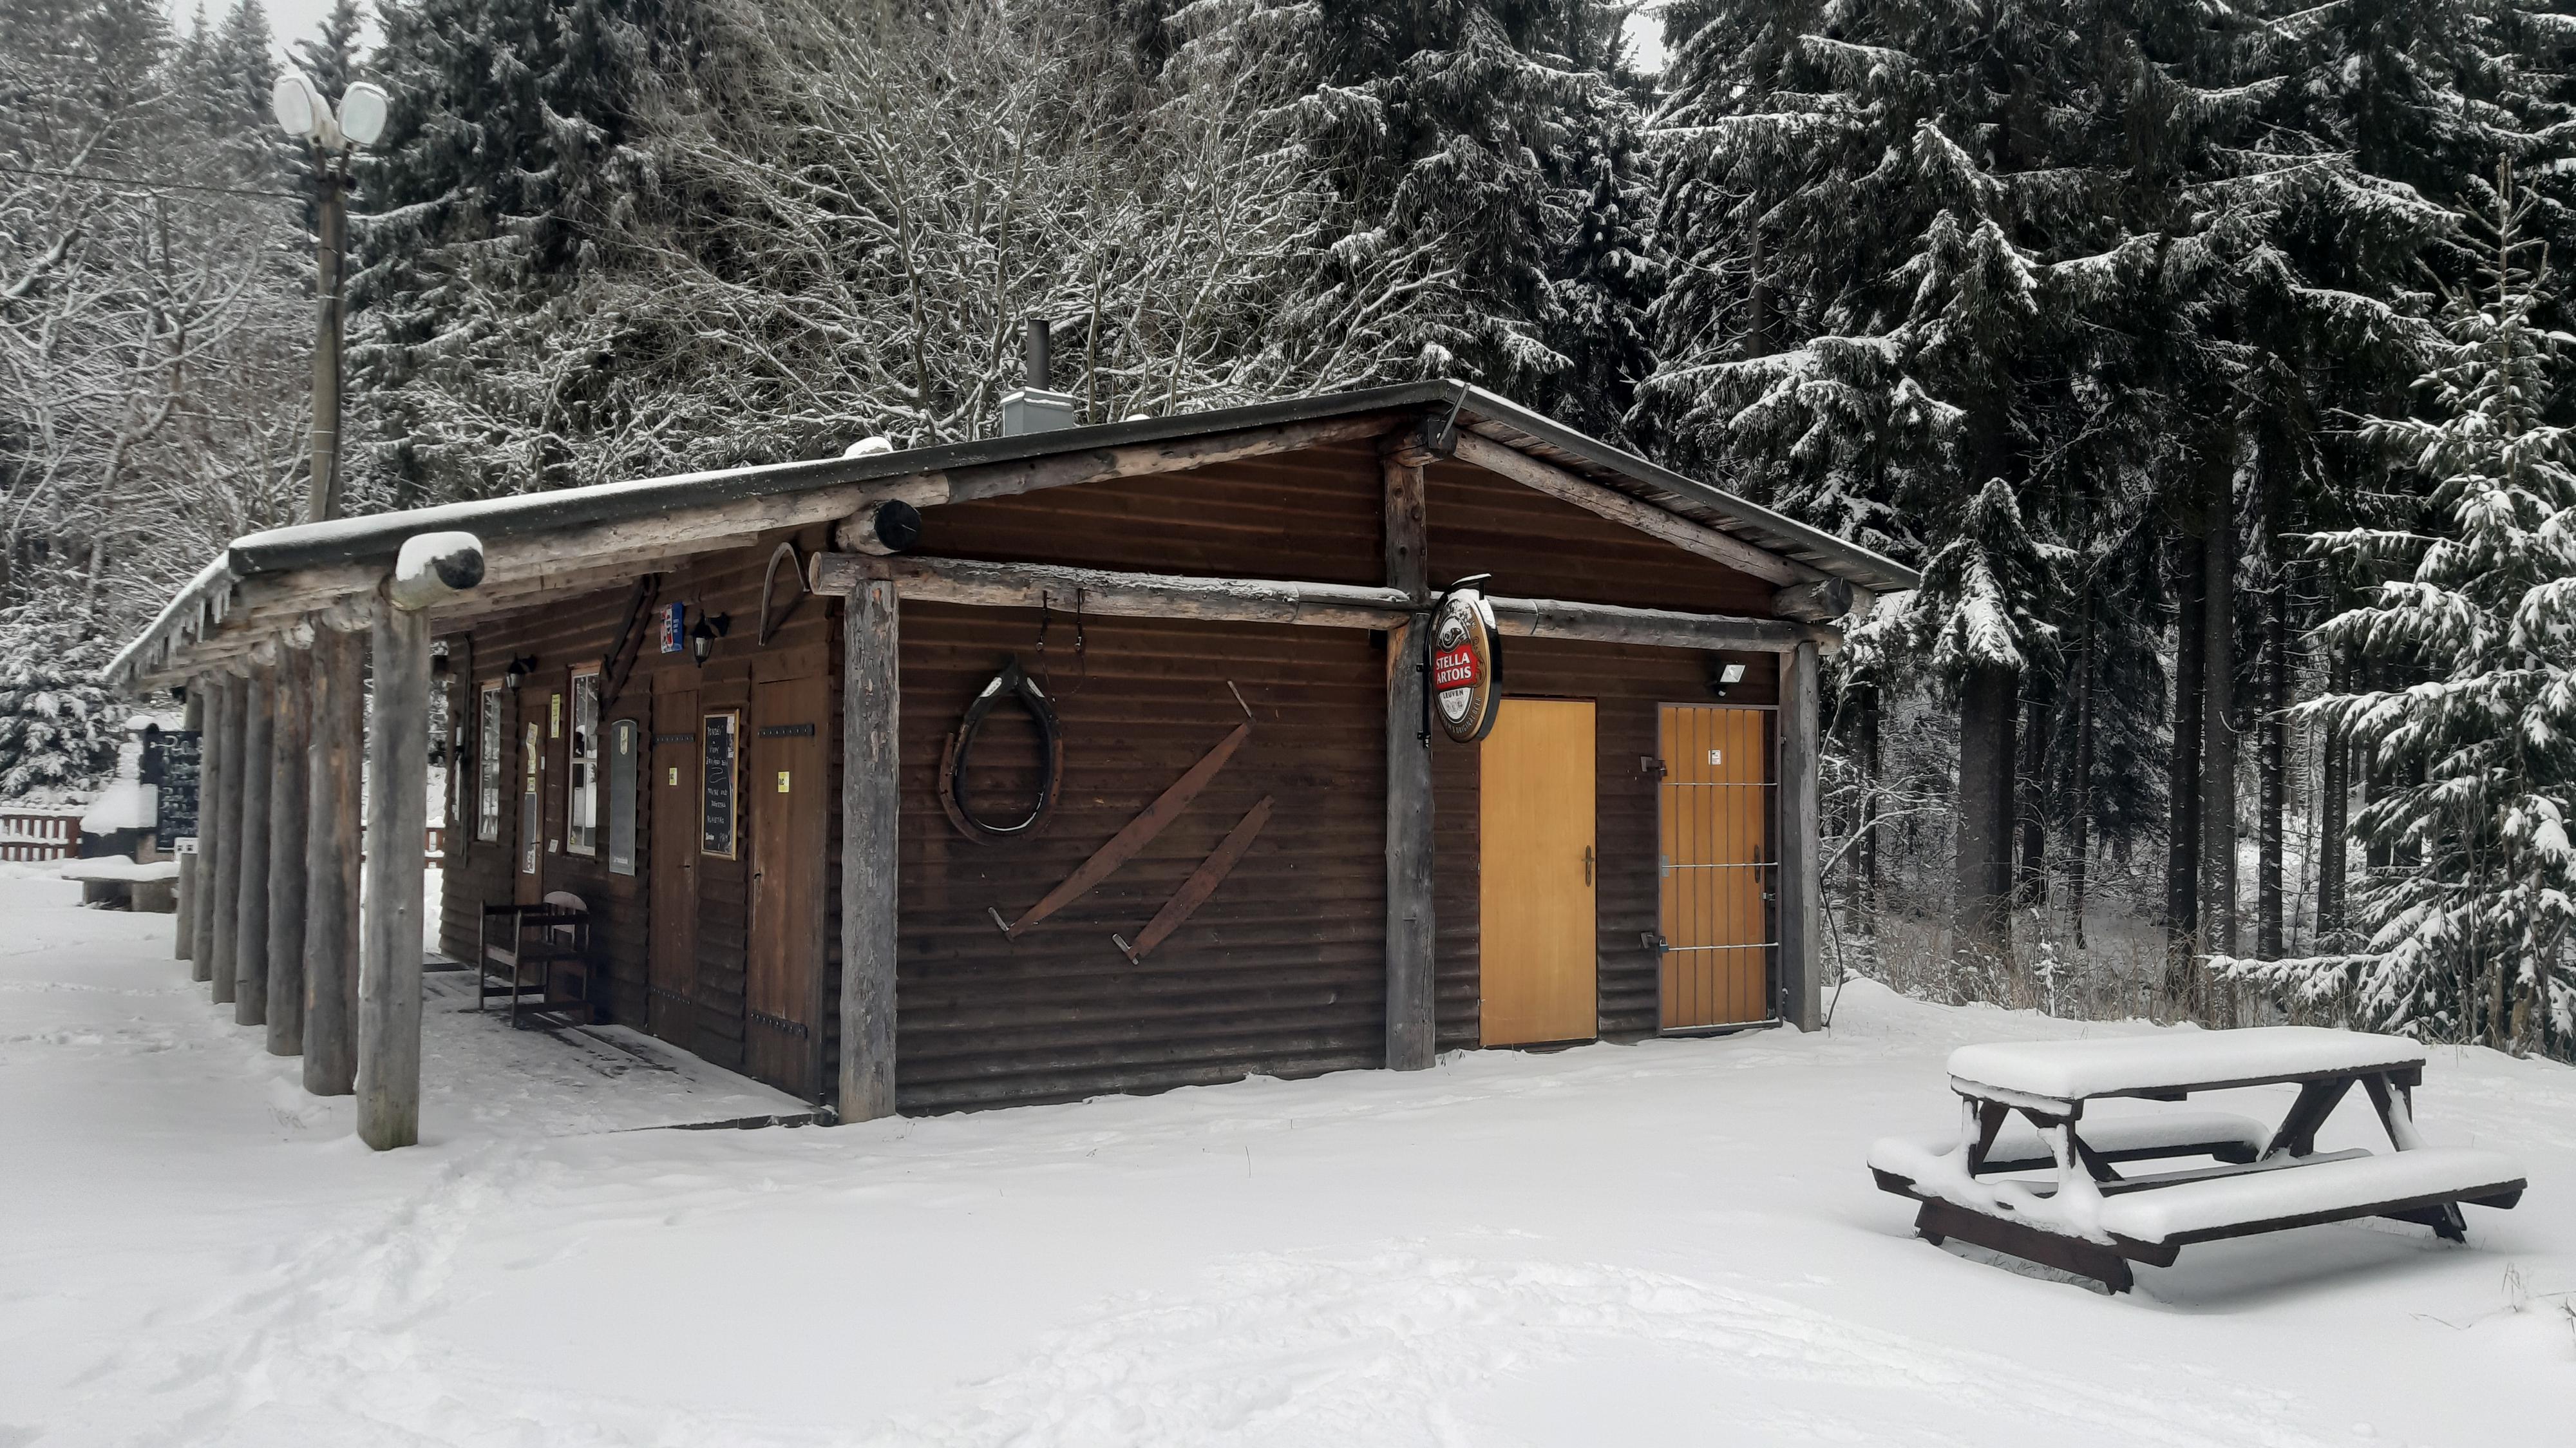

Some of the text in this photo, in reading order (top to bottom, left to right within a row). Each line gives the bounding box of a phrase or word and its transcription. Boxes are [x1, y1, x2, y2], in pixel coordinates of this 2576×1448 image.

[1436, 652, 1470, 671] STELLA
[1437, 665, 1472, 685] ARTOIS
[1443, 689, 1464, 699] LEUVEN
